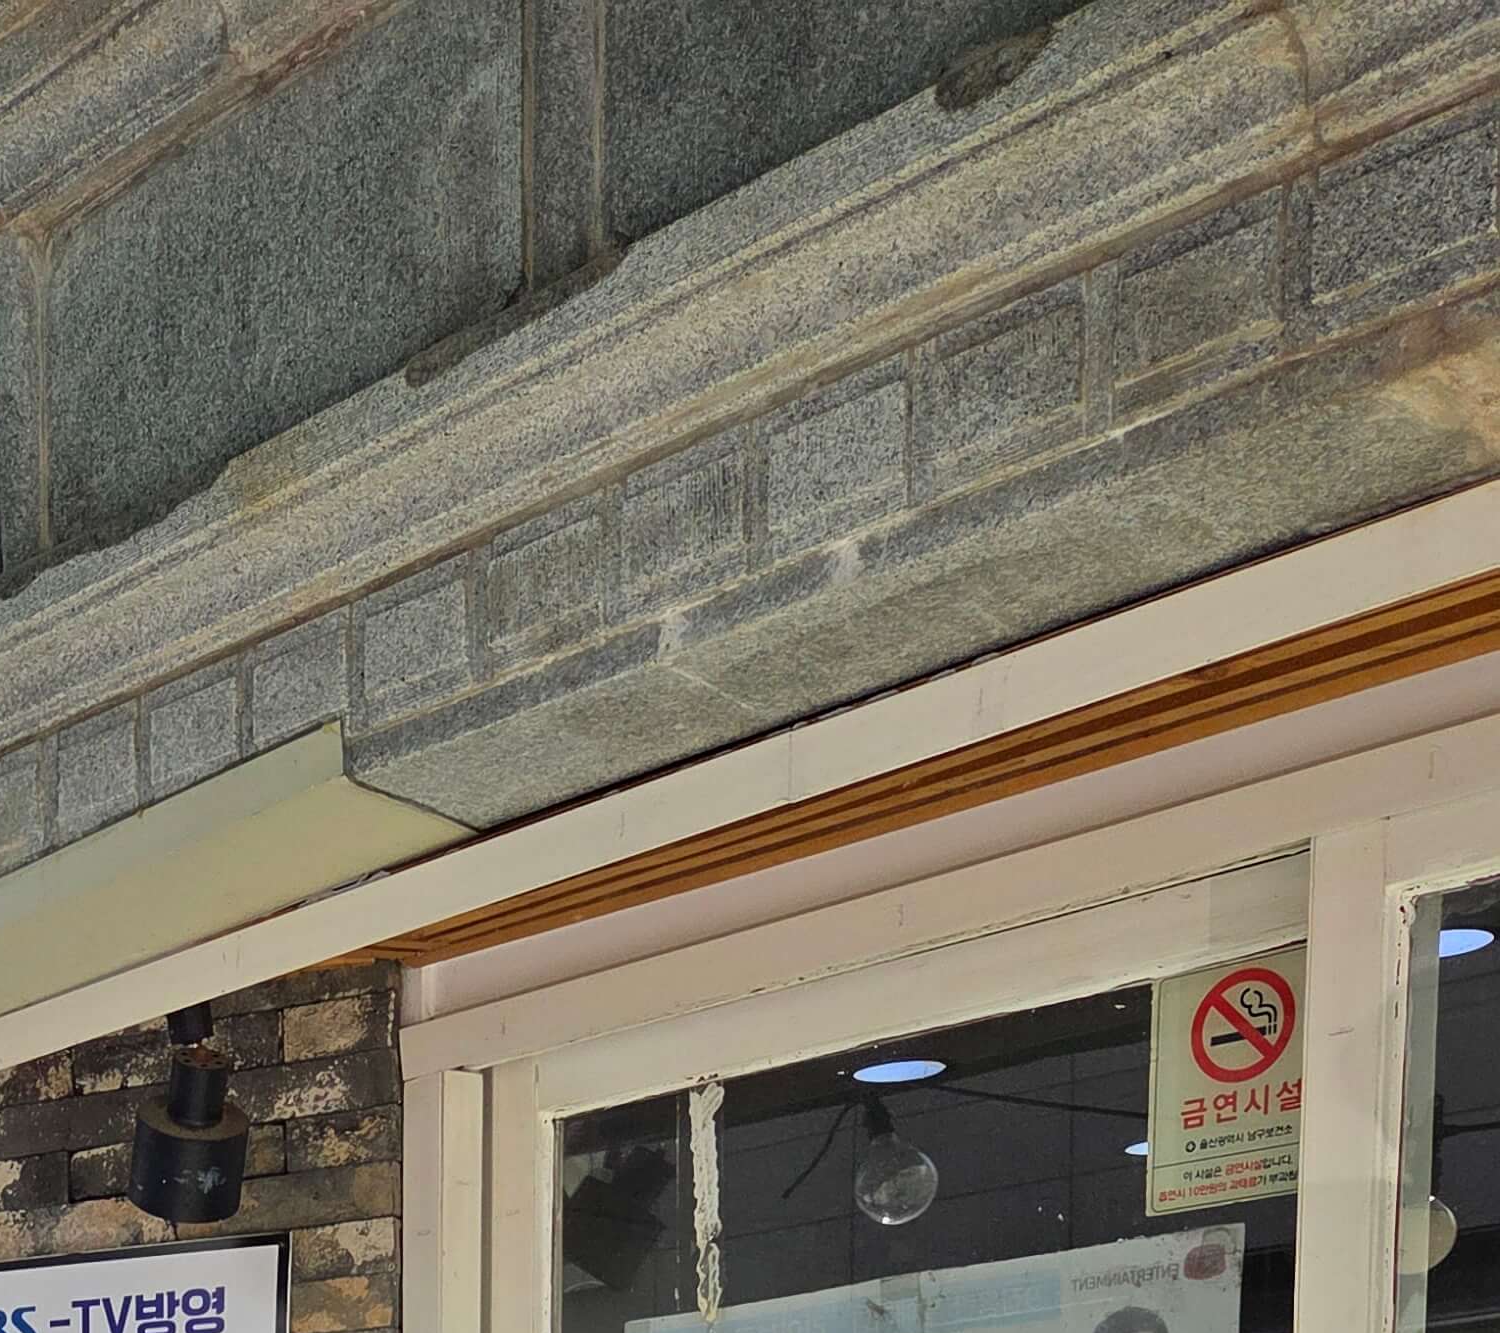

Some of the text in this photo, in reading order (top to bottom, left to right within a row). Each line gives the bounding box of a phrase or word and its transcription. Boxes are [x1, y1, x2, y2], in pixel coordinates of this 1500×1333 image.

[1180, 1078, 1301, 1130] 금연시설
[1183, 1171, 1193, 1181] 이
[1195, 1166, 1223, 1179] 시설은
